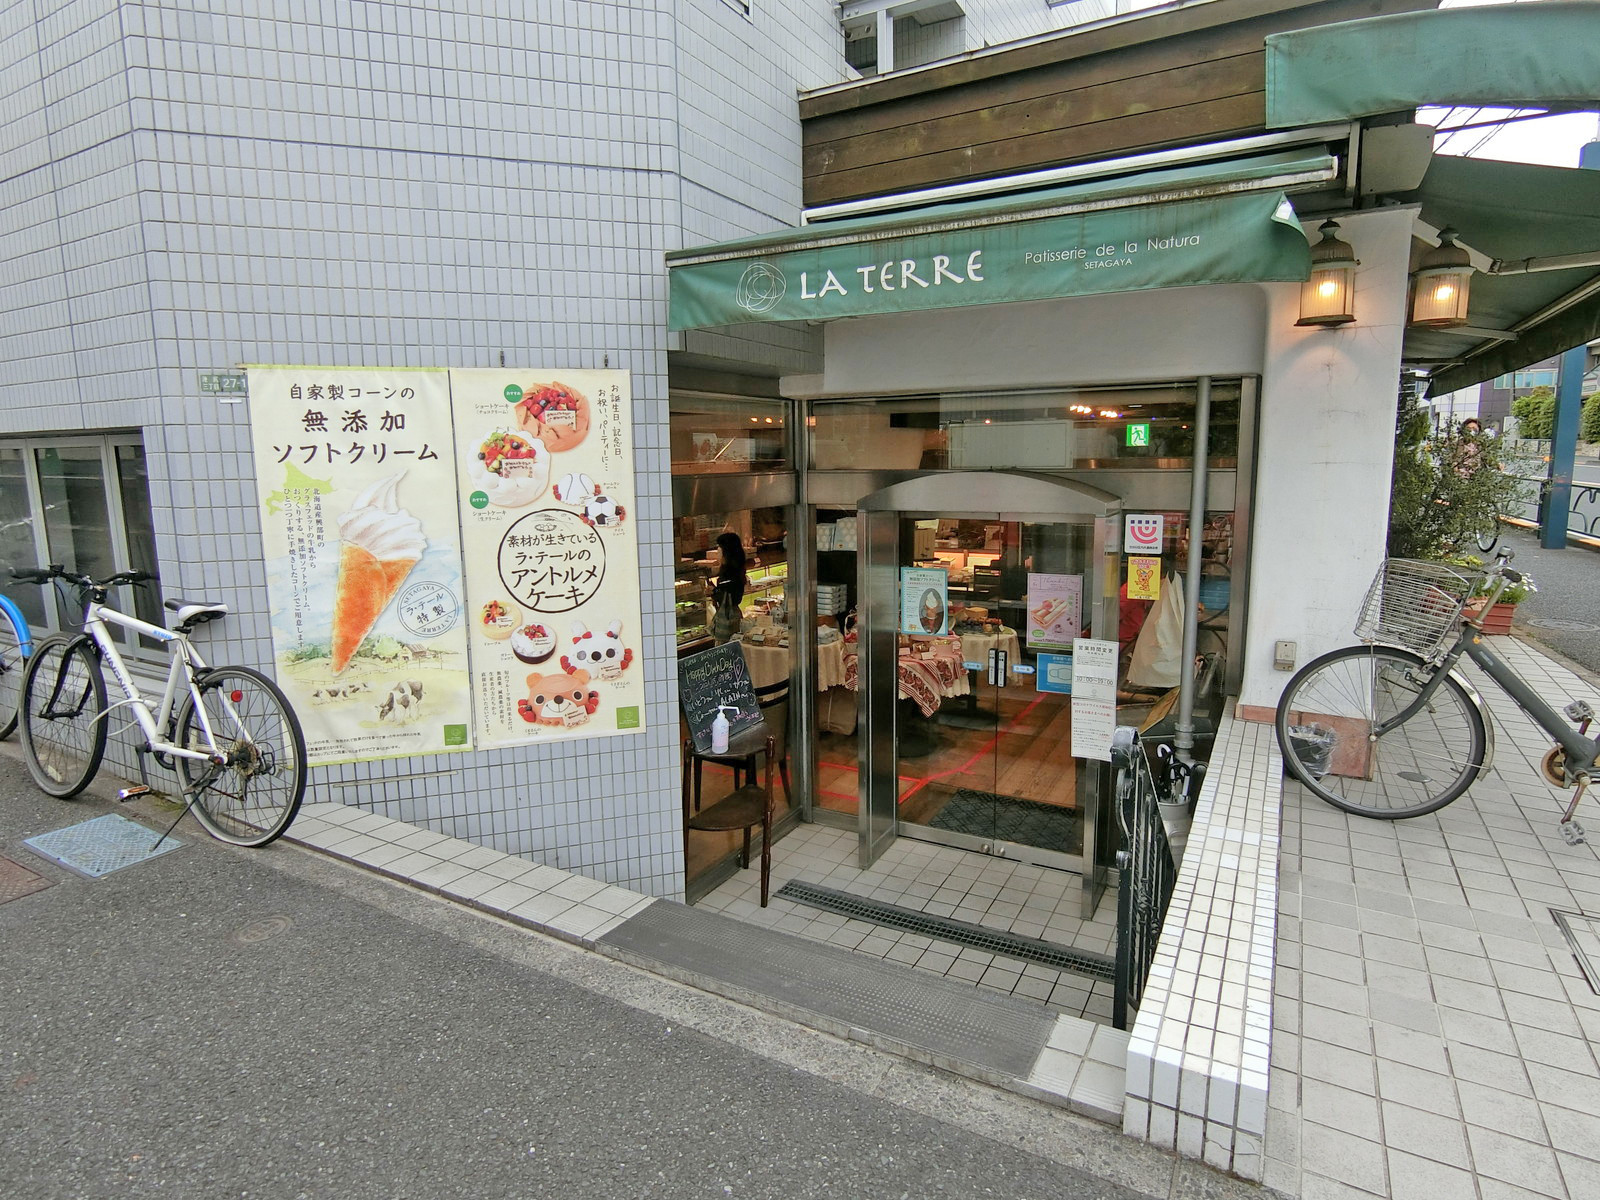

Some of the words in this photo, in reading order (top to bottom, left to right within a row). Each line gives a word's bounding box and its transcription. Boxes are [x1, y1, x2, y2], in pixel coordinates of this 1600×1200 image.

[1095, 243, 1115, 257] de
[1124, 240, 1138, 254] la
[1147, 234, 1201, 251] Natura
[800, 268, 848, 300] LA
[856, 249, 985, 294] TERRE
[1084, 258, 1133, 270] SETAGAYA
[290, 384, 415, 400] 自家製コーンの
[475, 403, 509, 411] ショートケーキ
[301, 409, 406, 432] 無添加
[610, 384, 623, 460] お誕生日、記念日、
[273, 442, 438, 464] ソフトクリーム
[303, 488, 317, 569] グラスフェッドの牛乳から
[313, 488, 325, 548] 北海道産興部町の
[507, 532, 597, 548] 素材が生きている
[515, 549, 591, 566] ラ・テールの
[511, 565, 598, 588] アントルメ
[403, 585, 435, 604] SETAGAYA
[406, 593, 444, 616] ラ・テール
[527, 586, 585, 608] ケーキ
[1078, 645, 1114, 654] 営業時間変更
